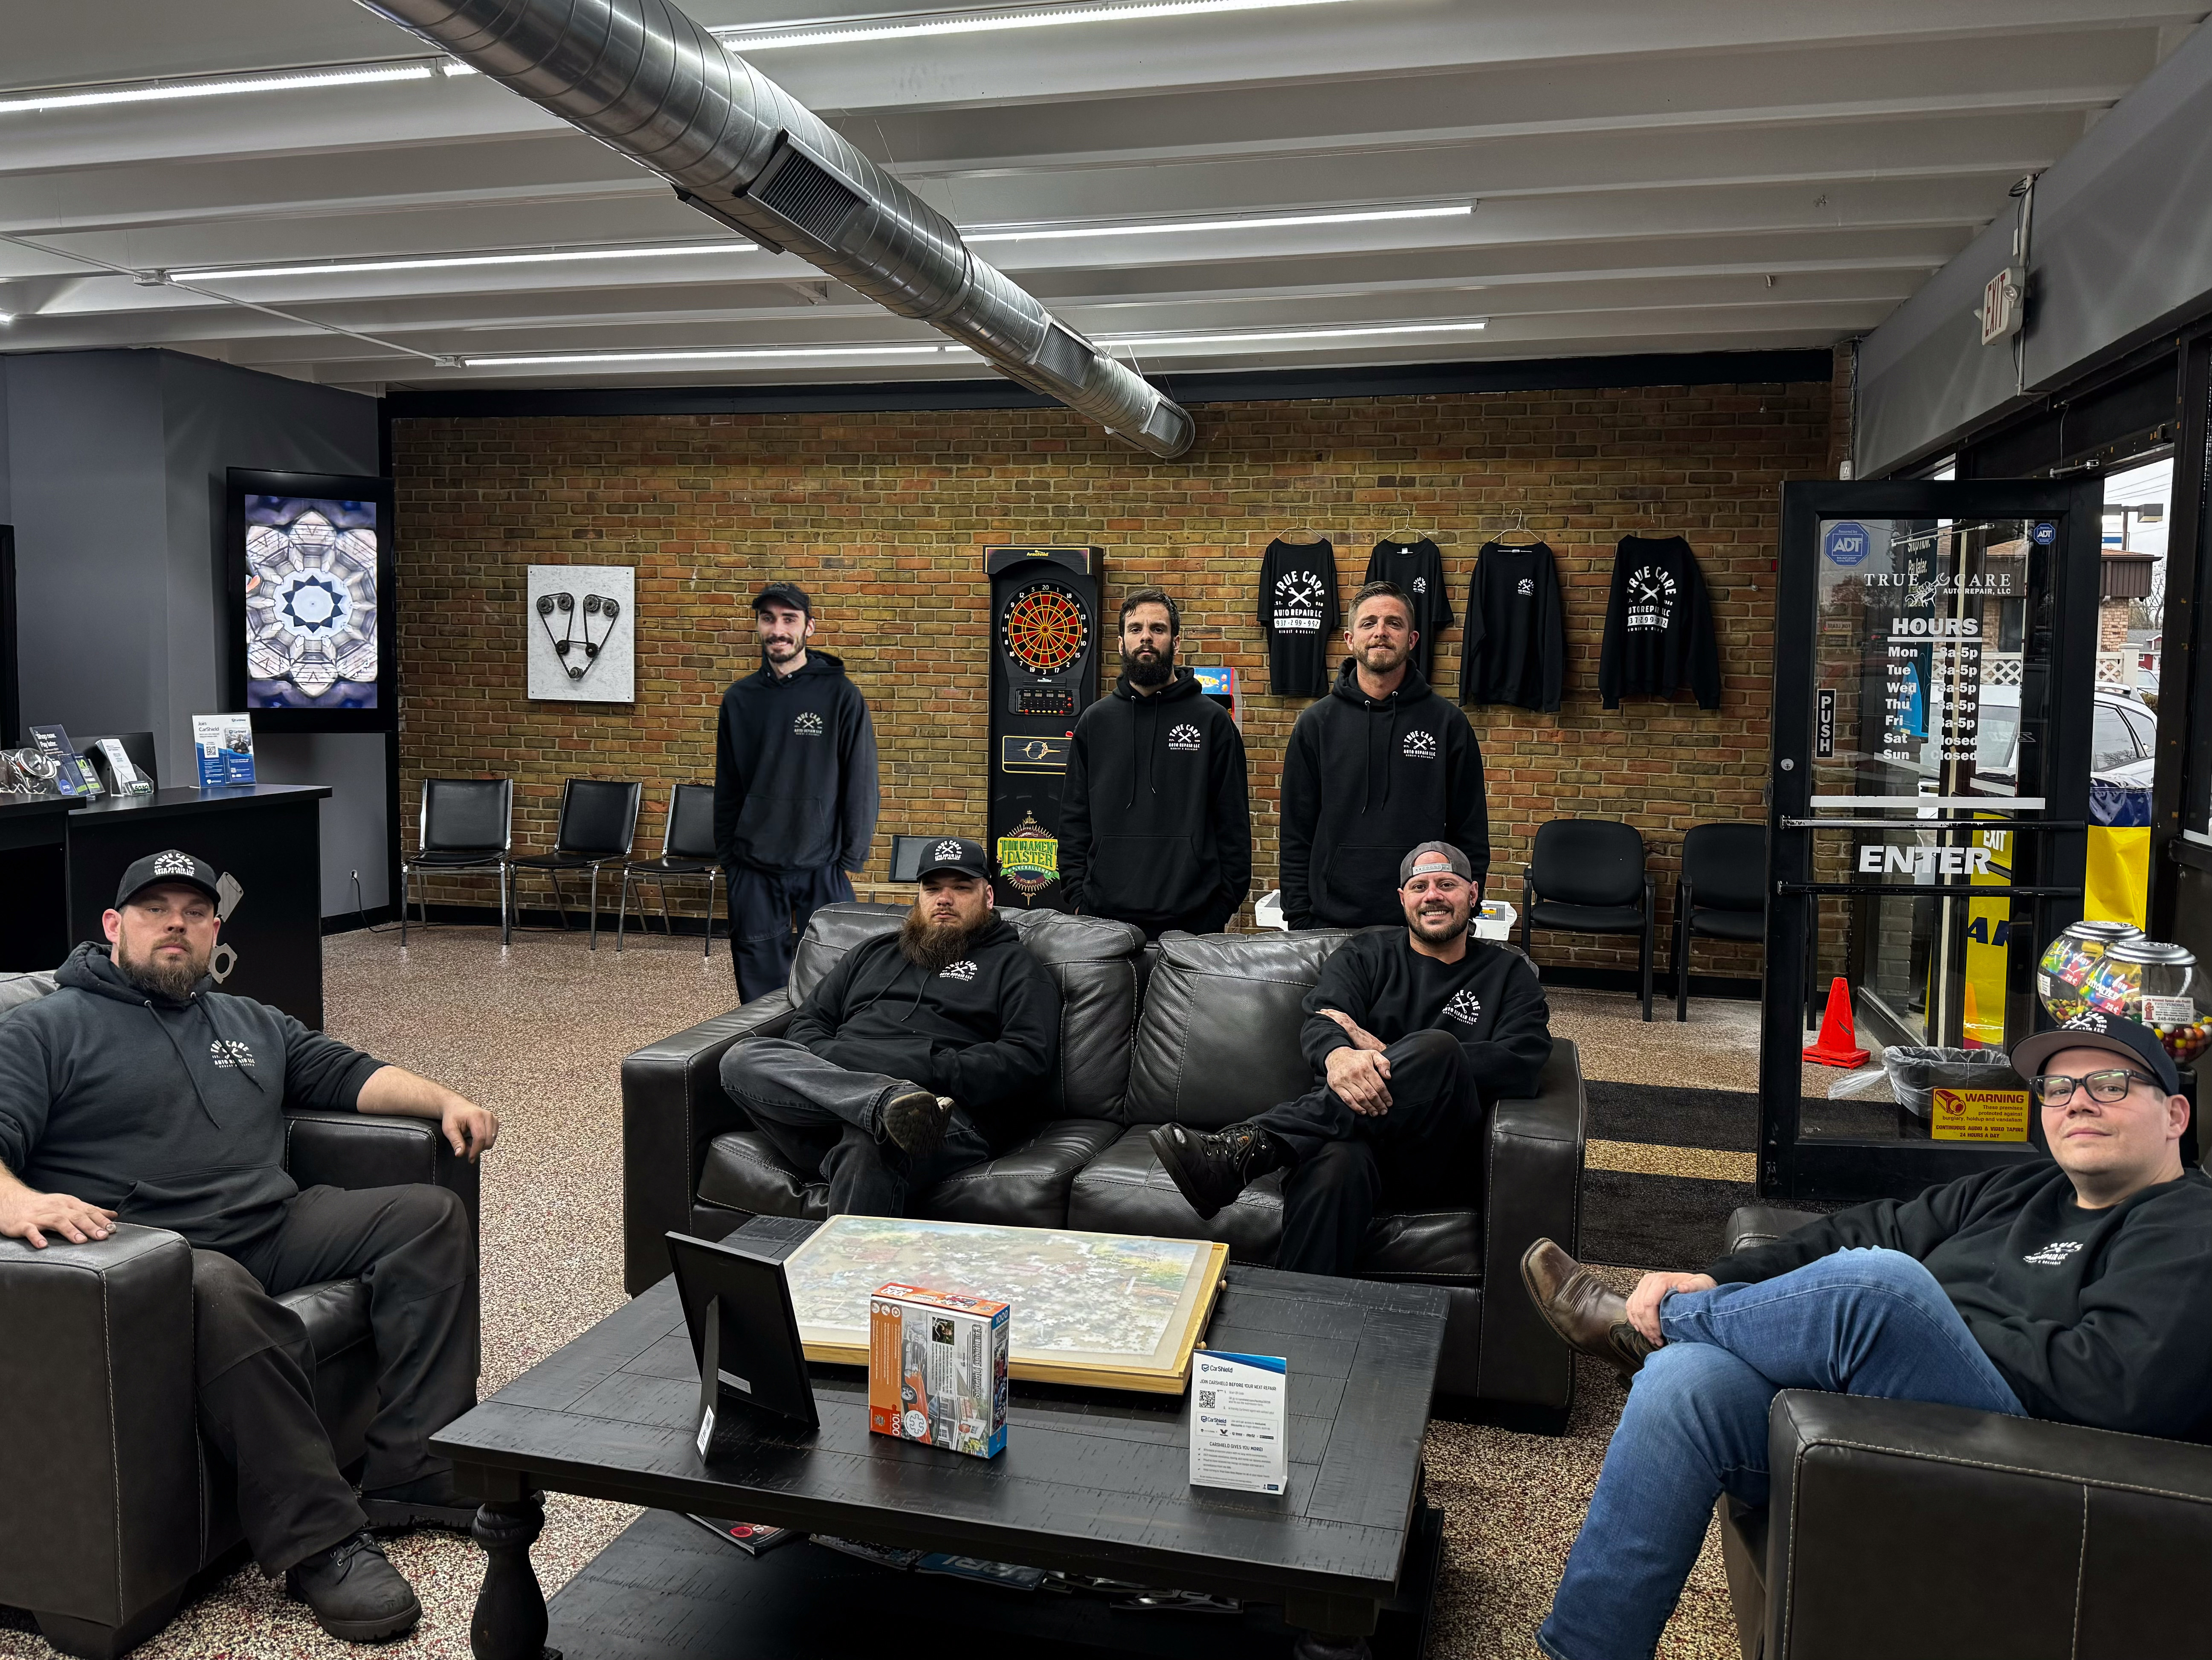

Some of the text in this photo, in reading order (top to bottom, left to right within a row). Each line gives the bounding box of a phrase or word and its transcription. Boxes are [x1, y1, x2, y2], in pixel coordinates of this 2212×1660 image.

[1985, 272, 2006, 337] EXIT
[1833, 537, 1862, 552] ADT
[1916, 558, 1927, 574] later.
[1275, 571, 1325, 597] TRUE CARE
[1626, 566, 1676, 595] TRUE CARE
[1864, 574, 2010, 586] TRUE CARE
[1290, 609, 1314, 617] REPAIR
[1892, 618, 1978, 636] HOURS
[1888, 646, 1978, 659] Mon 8a-5p
[1887, 665, 1977, 677] Tue 8a-5p
[1887, 682, 1976, 695] Wed 8a-5p
[1885, 699, 1976, 713] Thu 8a-5p
[795, 712, 823, 725] TRUE CARE
[1820, 696, 1832, 752] PUSH
[1885, 715, 1903, 726] Fri
[1169, 724, 1200, 738] TRUE CARE
[1404, 730, 1435, 746] TRUE CARE
[1883, 732, 1977, 746] Sat Closed
[1883, 749, 1977, 760] Sun Closed
[1983, 830, 2006, 852] EXIT
[1859, 845, 1992, 874] ENTER
[1467, 991, 1481, 1011] CARE
[210, 1040, 249, 1053] TRU CARE
[1965, 1093, 2024, 1103] WARNING
[880, 1287, 907, 1297] 1000
[995, 1309, 1008, 1324] 1000
[1210, 1365, 1233, 1373] CarShield
[892, 1413, 900, 1436] 1000
